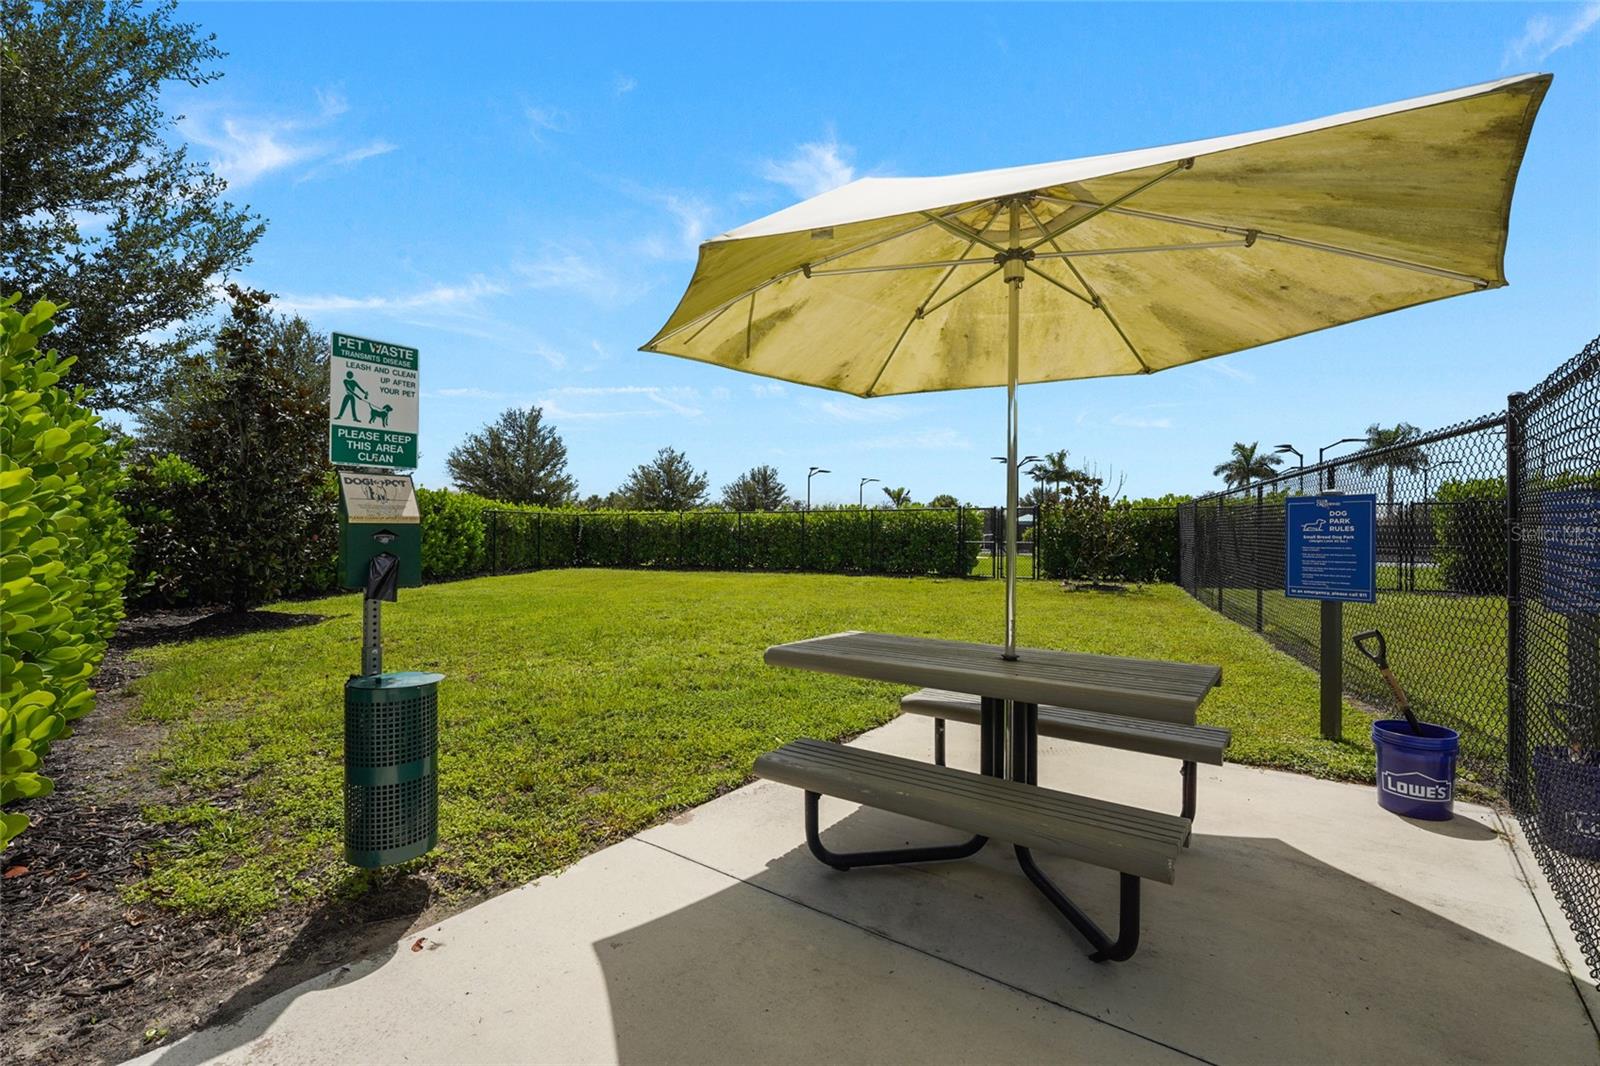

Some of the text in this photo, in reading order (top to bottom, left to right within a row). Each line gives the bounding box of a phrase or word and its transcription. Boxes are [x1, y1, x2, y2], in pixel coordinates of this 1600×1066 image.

[338, 336, 414, 361] PET WASTE
[340, 349, 411, 368] TRANSMITS DISEASE
[345, 361, 416, 379] LEASH AND CLEAN
[380, 386, 415, 398] YOUR PET
[393, 379, 416, 389] AFTER
[337, 428, 412, 444] PLEASE KEEP
[346, 440, 404, 454] THIS AREA
[357, 452, 394, 464] CLEAN
[1387, 776, 1447, 799] LOWE'S
